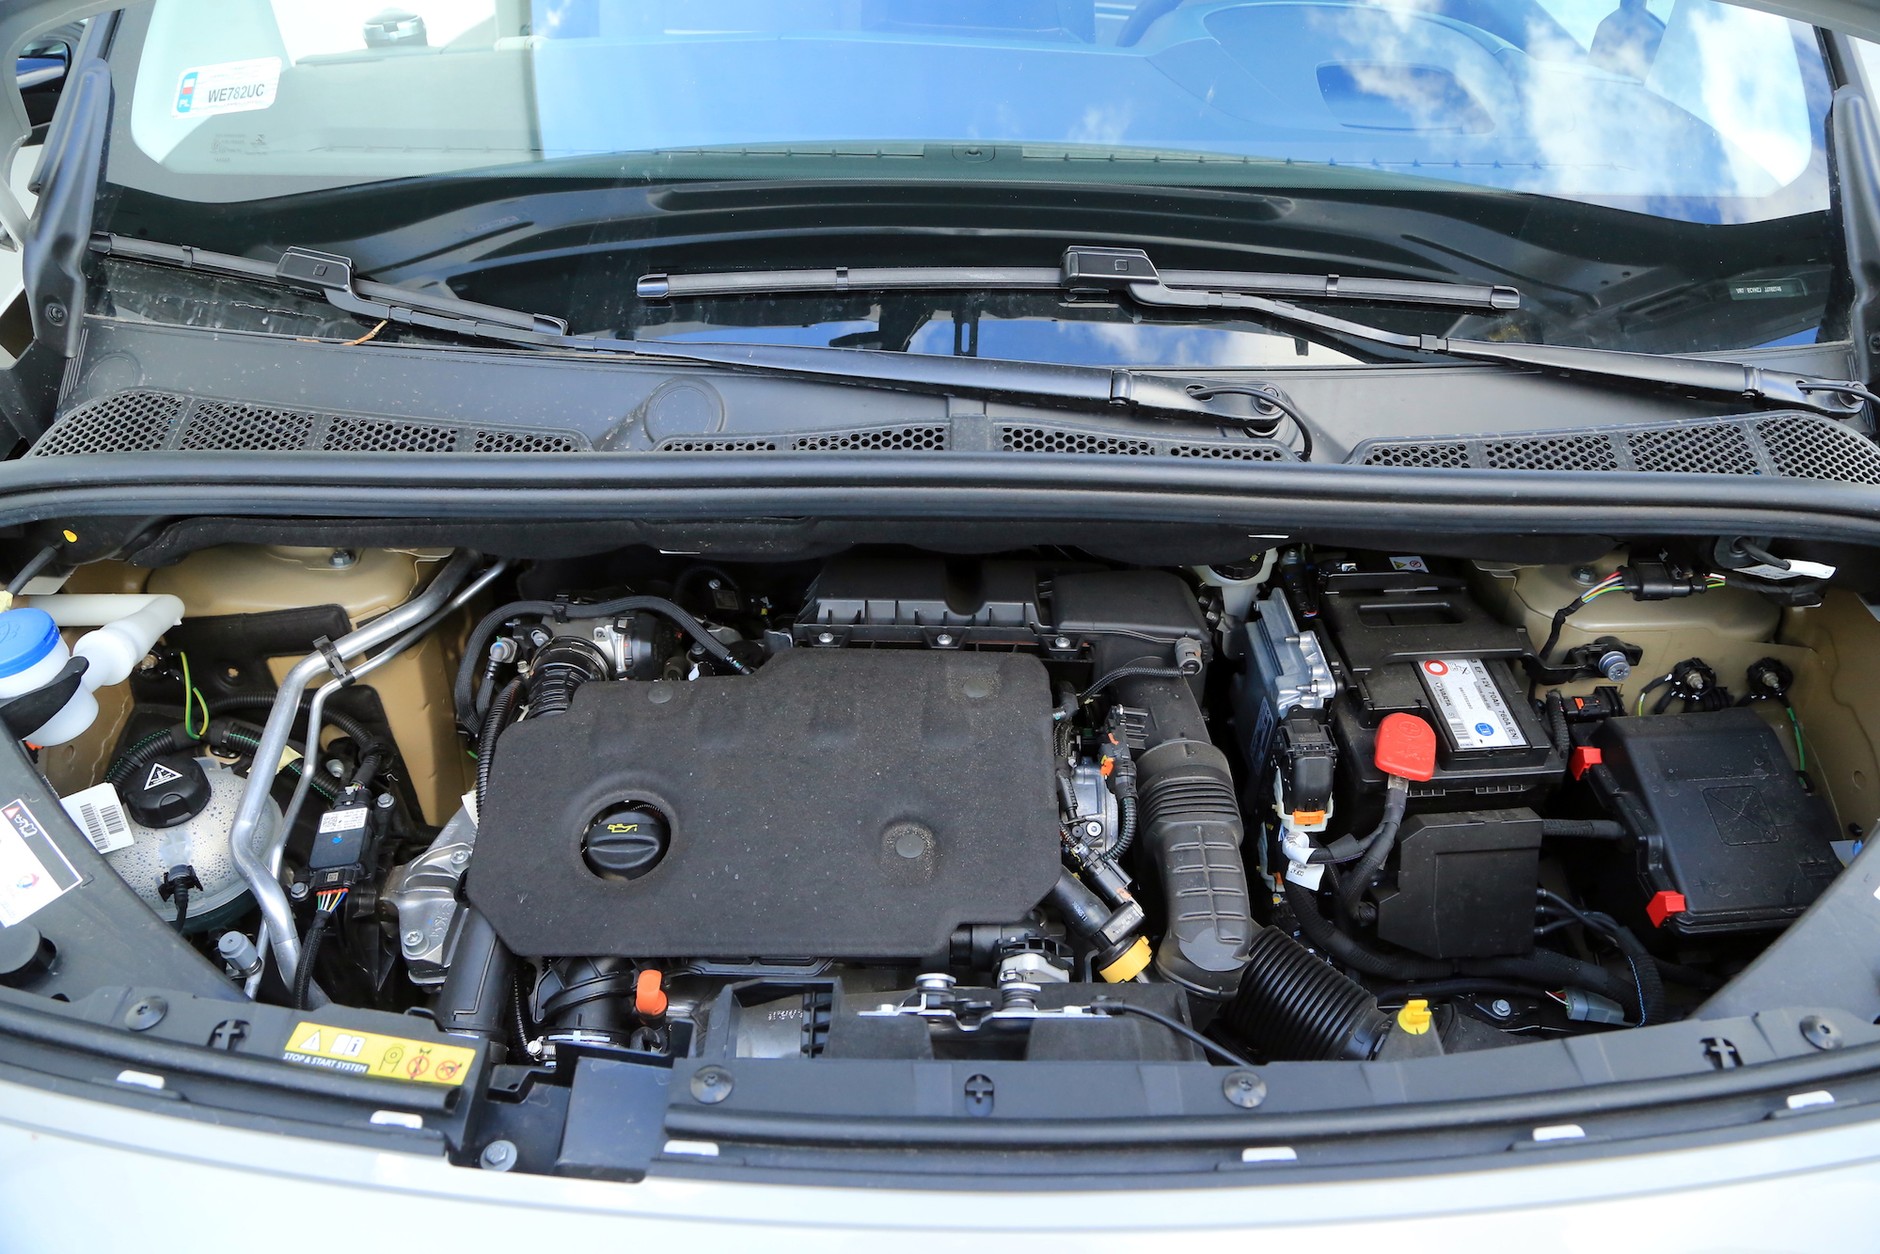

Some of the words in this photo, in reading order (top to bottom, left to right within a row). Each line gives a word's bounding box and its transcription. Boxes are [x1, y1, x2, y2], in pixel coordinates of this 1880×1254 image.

[179, 98, 190, 108] PL
[208, 83, 265, 103] WE782UC
[1438, 688, 1452, 707] VARTA
[1480, 677, 1491, 688] 12V
[1488, 691, 1500, 706] 70Ah
[1498, 710, 1511, 726] 760A
[1506, 726, 1519, 740] (EN)
[283, 1052, 304, 1062] STOP
[311, 1057, 336, 1067] START
[336, 1061, 368, 1072] SYSTEM
